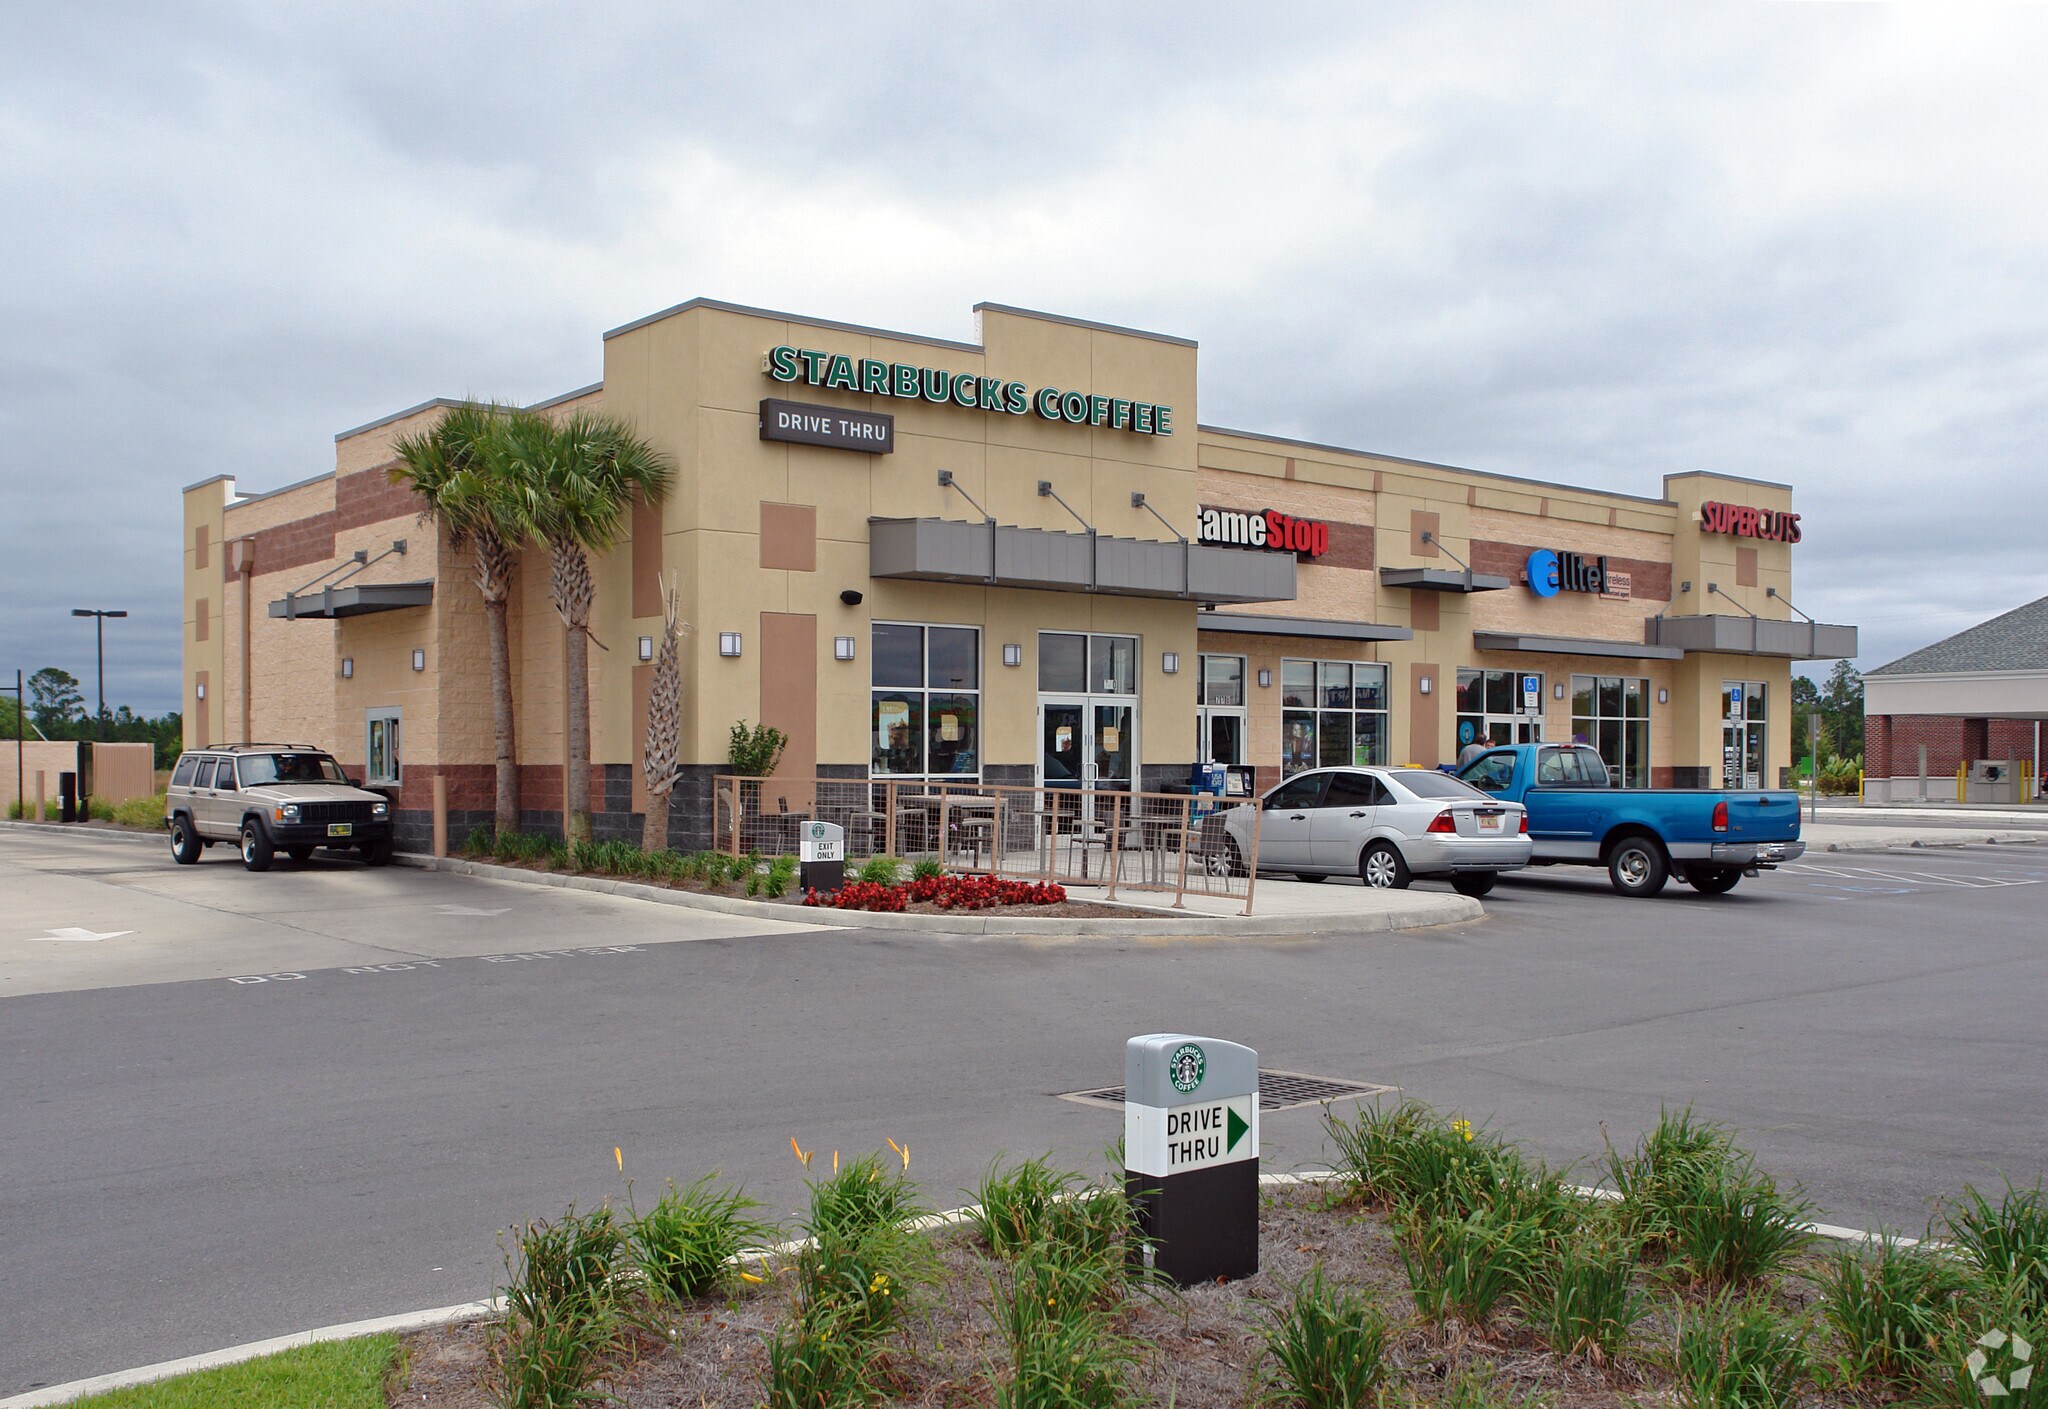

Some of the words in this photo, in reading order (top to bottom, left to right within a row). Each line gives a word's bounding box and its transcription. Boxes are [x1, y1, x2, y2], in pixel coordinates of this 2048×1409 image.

[769, 345, 1028, 415] STARBUCKS
[1033, 387, 1174, 437] COFFEE
[779, 412, 832, 434] DRIVE
[839, 420, 886, 441] THRU
[1701, 501, 1801, 544] SUPERCUTS
[1606, 573, 1630, 586] ireless
[227, 972, 307, 985] DO
[342, 960, 442, 974] NOT
[479, 945, 647, 963] ENTER
[1171, 1046, 1204, 1069] STARBUCKS
[1174, 1078, 1200, 1091] COFFEE
[1168, 1107, 1222, 1136] DRIVE
[1168, 1136, 1219, 1165] THRU
